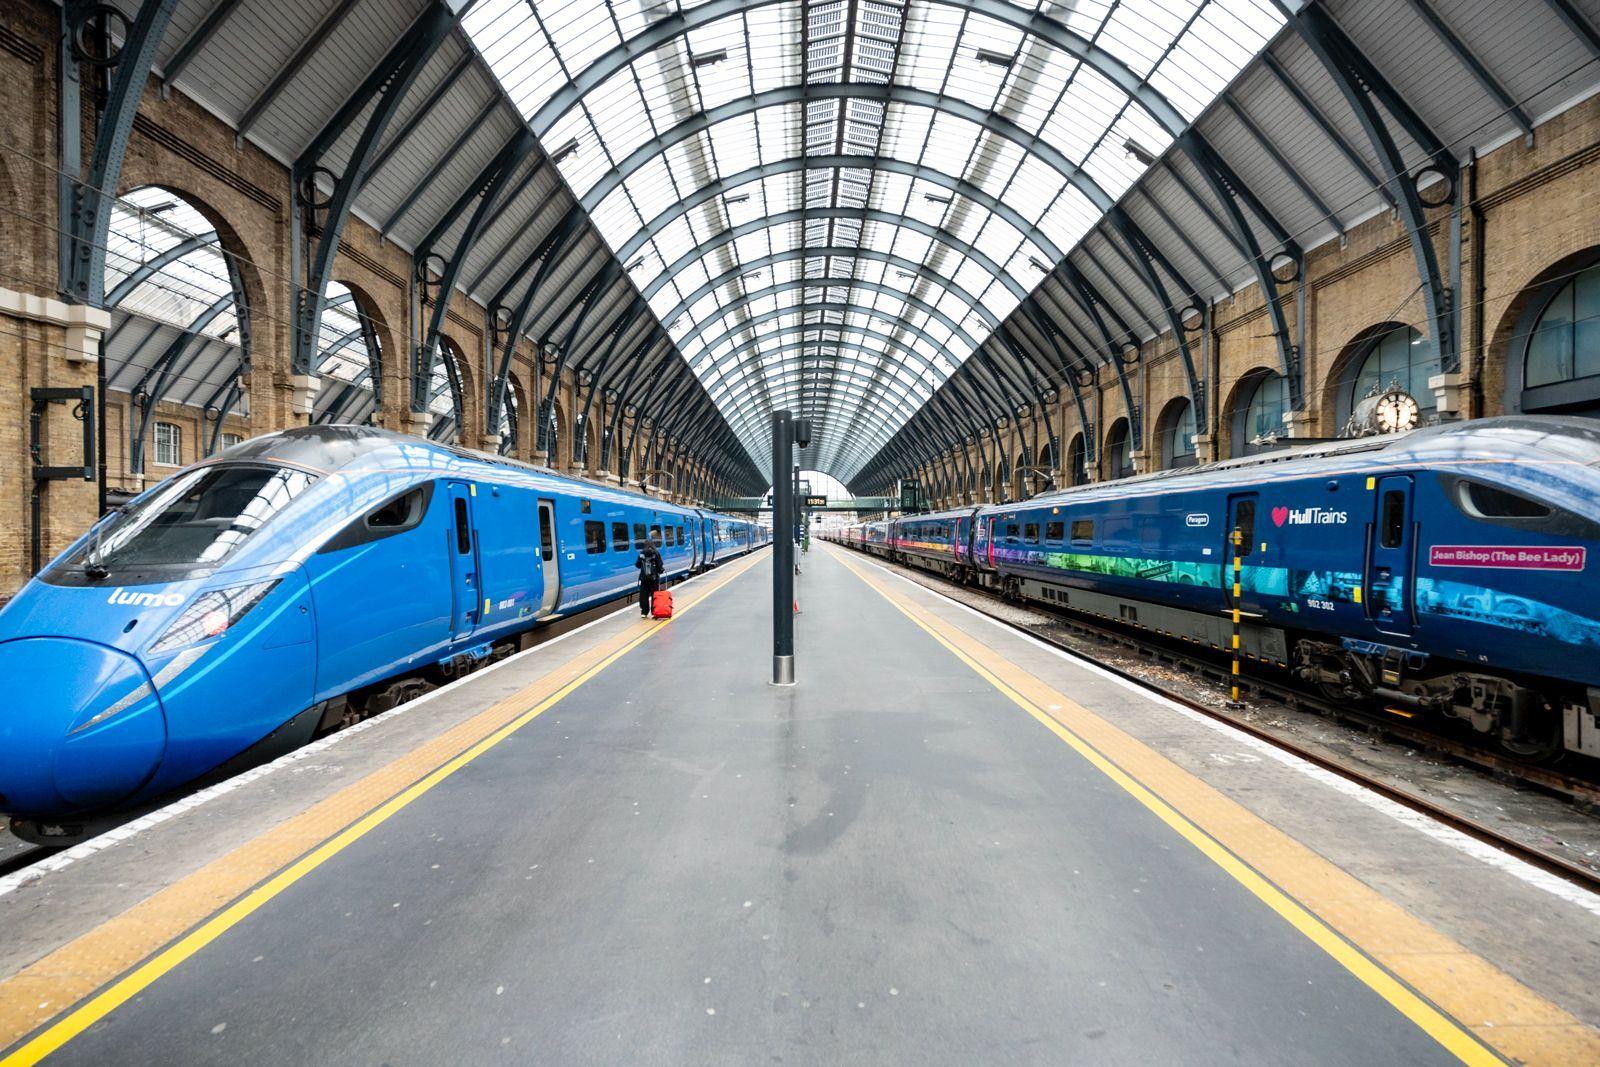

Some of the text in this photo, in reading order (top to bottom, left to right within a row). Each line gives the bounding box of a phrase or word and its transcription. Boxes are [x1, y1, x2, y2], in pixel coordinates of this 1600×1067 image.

[1188, 516, 1207, 525] Paragon
[1433, 551, 1580, 565] Jean Bishop (The Bee Lady)
[107, 586, 185, 607] lumo
